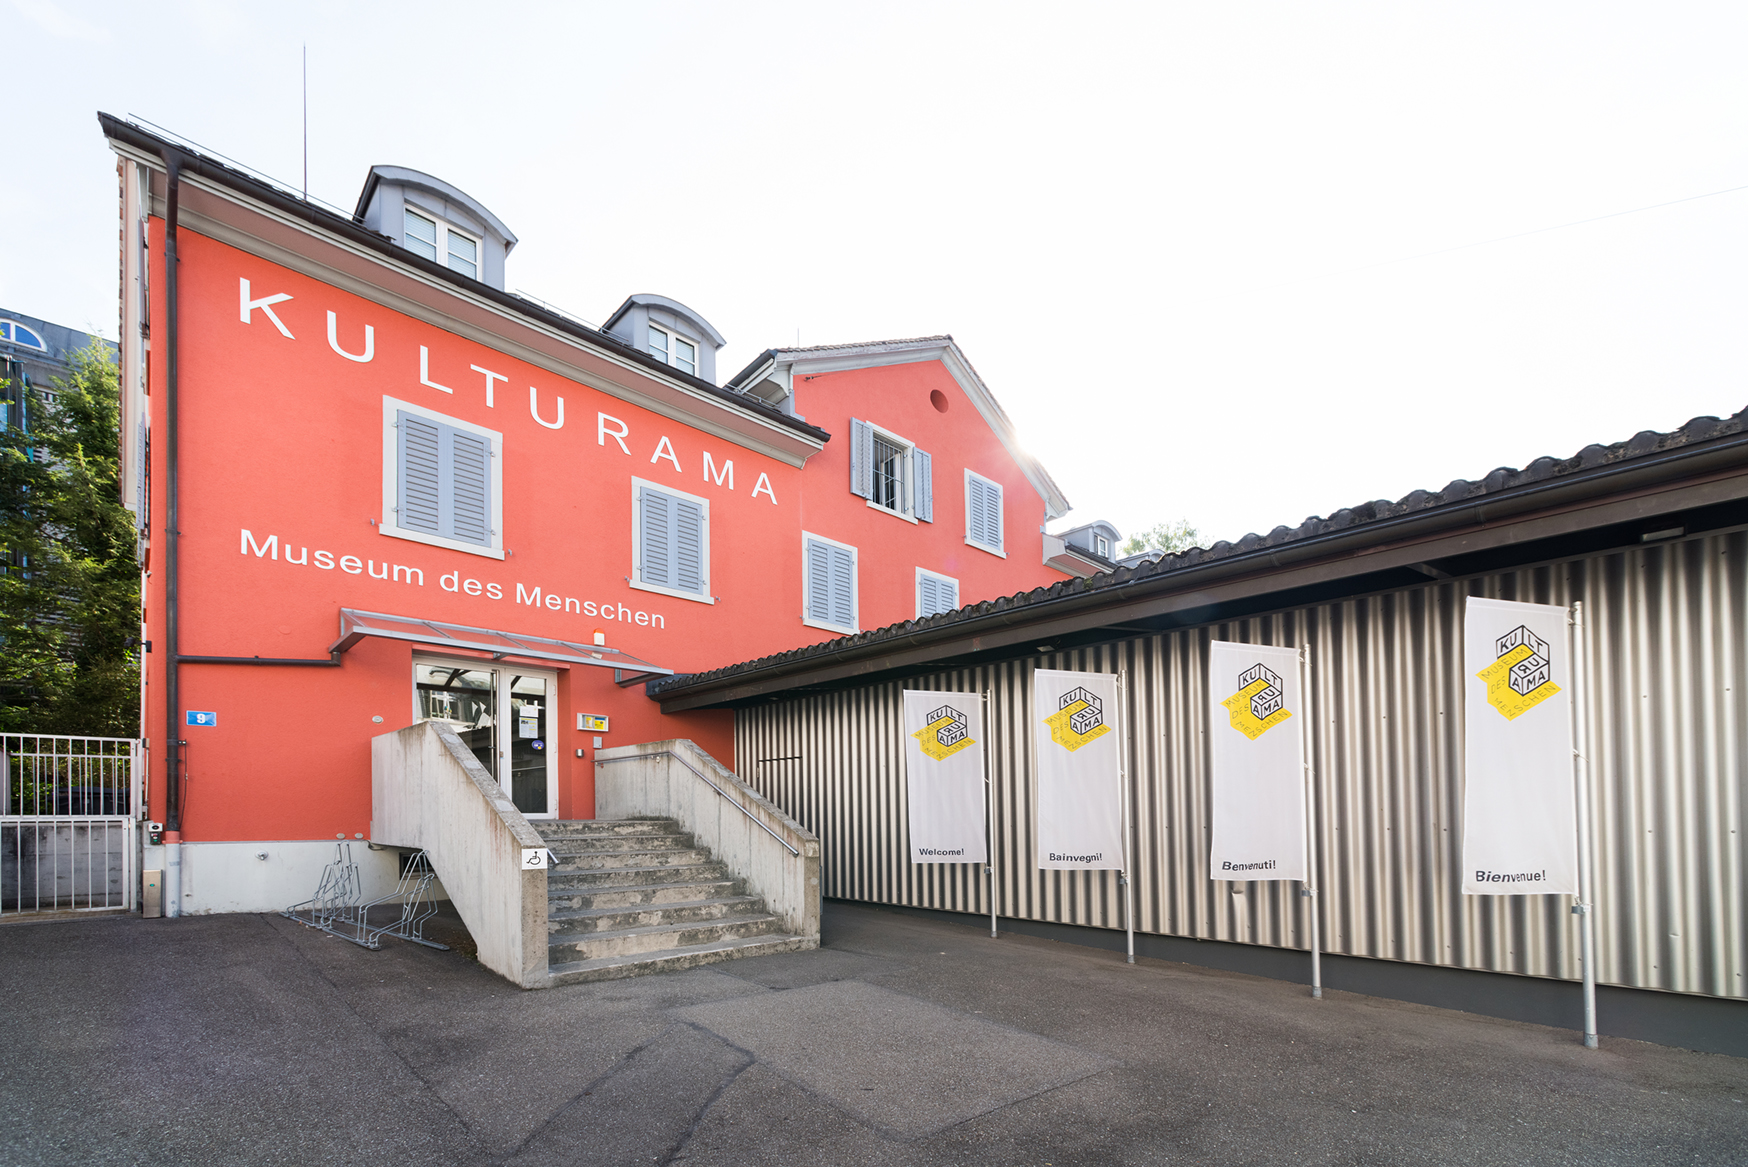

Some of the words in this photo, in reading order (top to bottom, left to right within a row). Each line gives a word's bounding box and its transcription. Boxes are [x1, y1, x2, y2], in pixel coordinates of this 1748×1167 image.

[239, 277, 778, 505] KULTURAMA
[240, 529, 424, 587] Museum
[439, 570, 503, 600] des
[515, 583, 666, 629] Menschen
[1481, 648, 1528, 679] MUSEUM
[1226, 682, 1264, 707] MUSEUM
[197, 714, 206, 723] 9
[1232, 704, 1249, 719] DES
[918, 848, 964, 856] Welcome!
[1050, 853, 1102, 863] Bainvegni!
[1221, 859, 1276, 871] Benvenuti!
[1476, 869, 1547, 883] Bienvenue!
